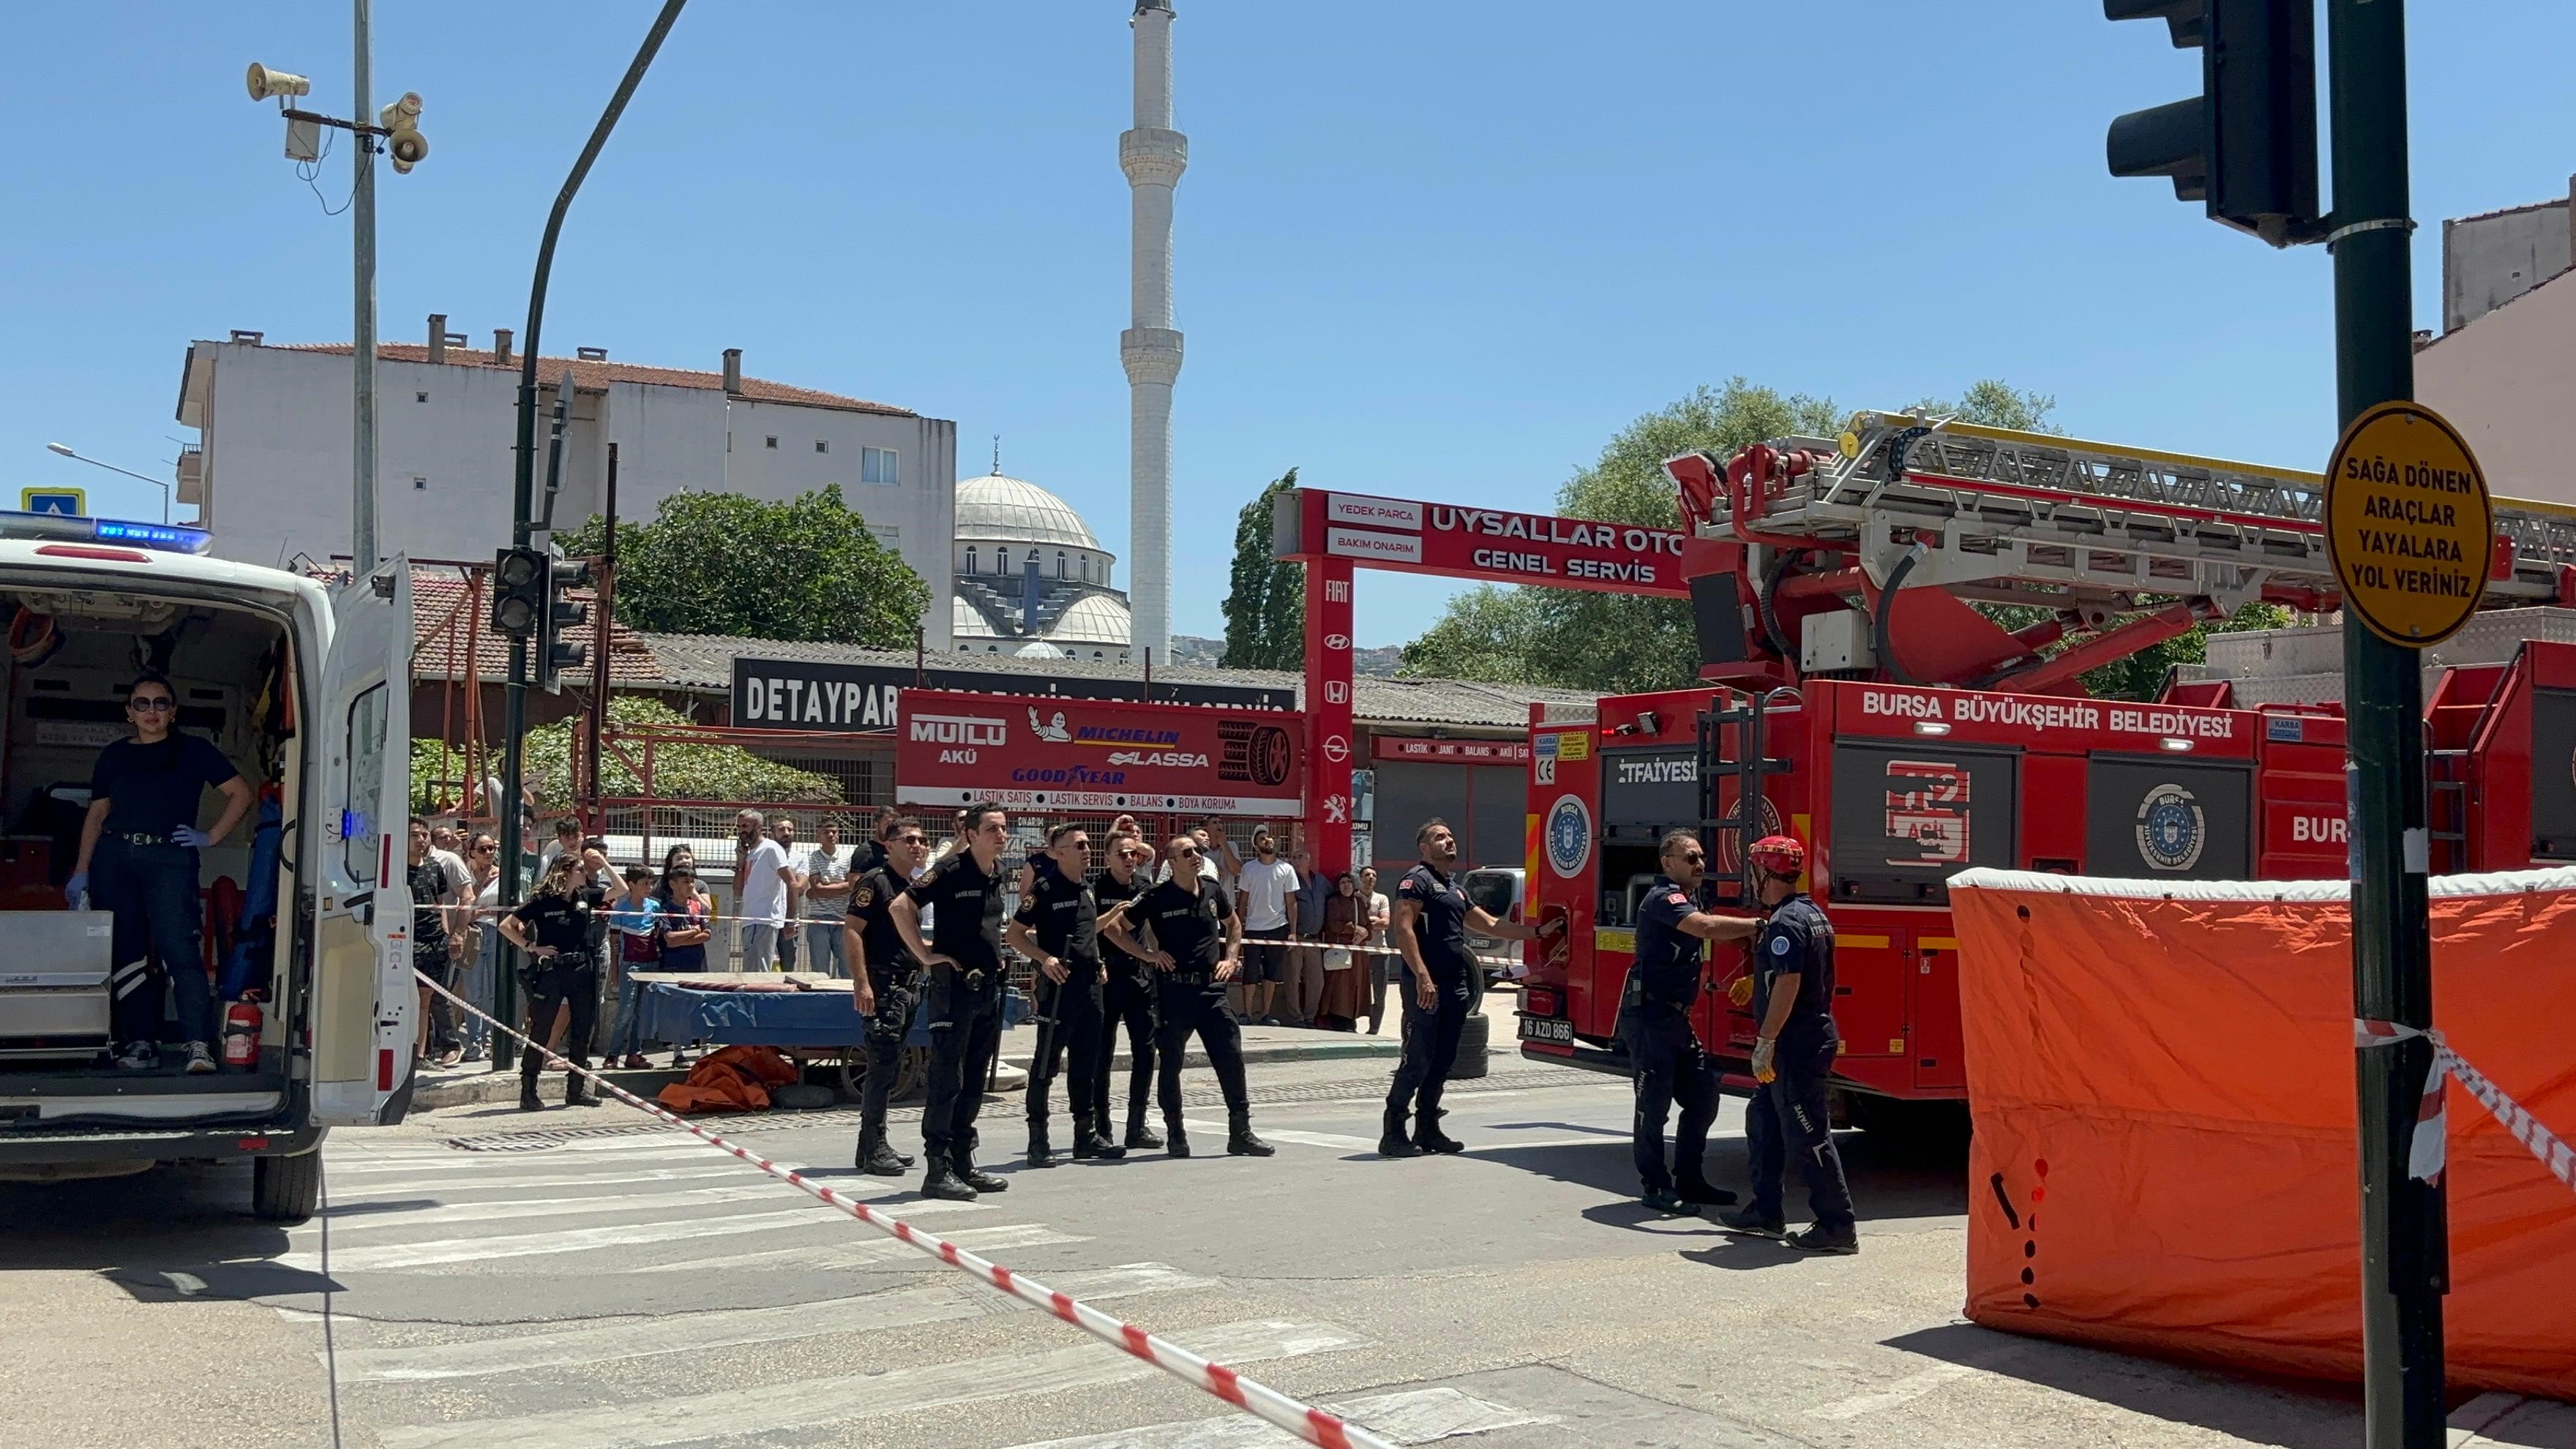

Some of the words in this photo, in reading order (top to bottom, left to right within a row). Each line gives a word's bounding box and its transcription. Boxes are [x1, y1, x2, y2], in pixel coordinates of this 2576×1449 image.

[2347, 455, 2399, 484] SAĞA
[2405, 460, 2471, 494] DÖNEN
[1338, 503, 1376, 517] YEDEK
[2364, 495, 2455, 527] ARAÇLAR
[1432, 506, 1616, 550] UYSALLAR
[1338, 538, 1371, 550] BAKIM
[1373, 540, 1414, 554] ONARIM
[2358, 529, 2463, 562] YAYALARA
[1473, 549, 1557, 575] GENEL
[1566, 559, 1655, 583] SERVİS
[1325, 580, 1349, 604] FIAT
[2351, 563, 2389, 590] YOL
[2394, 566, 2471, 597] VERİNİZ
[746, 677, 917, 726] DETAYPAR
[1863, 692, 1943, 719] BURSA
[1954, 694, 2100, 731] BÜYÜKŞEHİR
[2110, 708, 2233, 738] BELEDİYESİ
[910, 714, 1007, 746] MUTLU
[1078, 726, 1180, 744] MICHELIN
[939, 749, 977, 764] AKÜ
[1134, 752, 1209, 768] LASSA
[1406, 742, 1428, 753] LASTİK
[1439, 745, 1454, 755] JANT
[1465, 746, 1489, 757] BALANS
[1500, 746, 1513, 757] AKÜ
[1519, 749, 1529, 758] SAT
[973, 790, 1005, 803] LASTİK
[1007, 792, 1033, 806] SATIŞ
[1050, 793, 1080, 806] LASTİK
[1083, 793, 1113, 806] SERVİS
[1131, 795, 1163, 807] BALANS
[1179, 797, 1199, 809] BOYA
[1202, 798, 1236, 809] KORUMA
[2294, 816, 2351, 843] BUR
[1524, 1019, 1533, 1036] 16
[1535, 1022, 1551, 1038] AZD
[1553, 1024, 1570, 1041] 866
